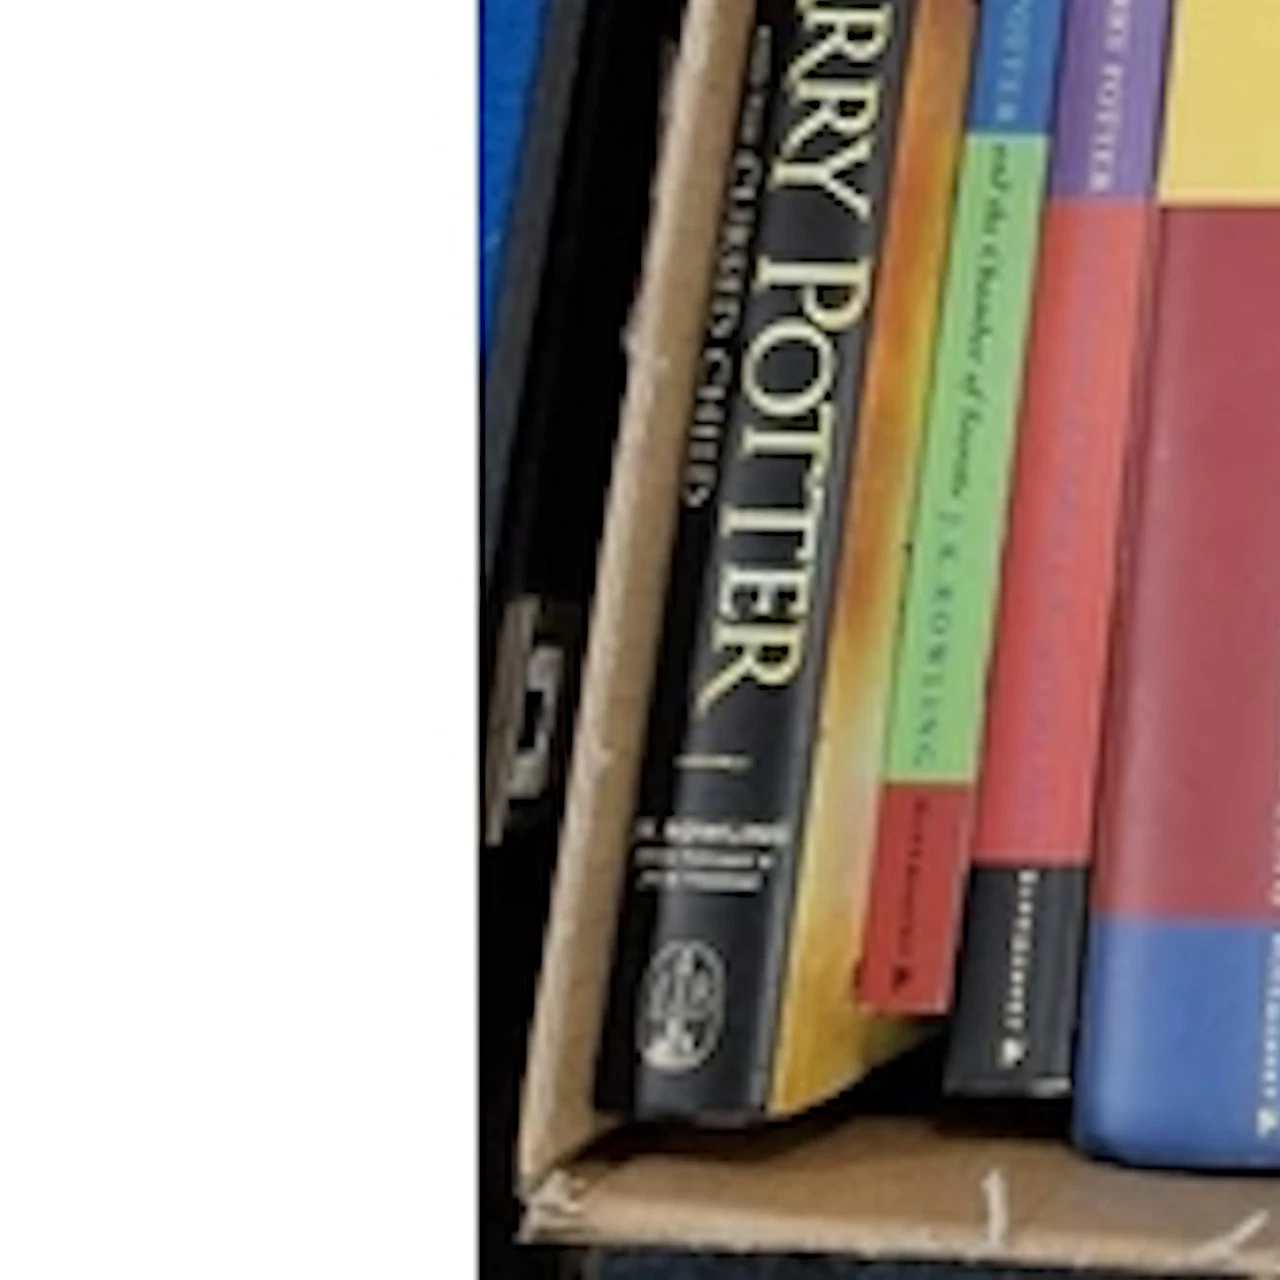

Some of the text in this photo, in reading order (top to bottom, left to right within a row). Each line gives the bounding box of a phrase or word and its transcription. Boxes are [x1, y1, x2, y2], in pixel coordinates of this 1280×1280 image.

[985, 144, 1016, 199] and
[1082, 63, 1127, 194] POTTER
[708, 160, 762, 340] CURSED
[980, 202, 1009, 239] the
[964, 244, 1003, 366] Chamber
[960, 372, 988, 400] of
[693, 255, 872, 717] POTTER
[950, 407, 984, 500] Secrets
[912, 586, 960, 768] ROWLING
